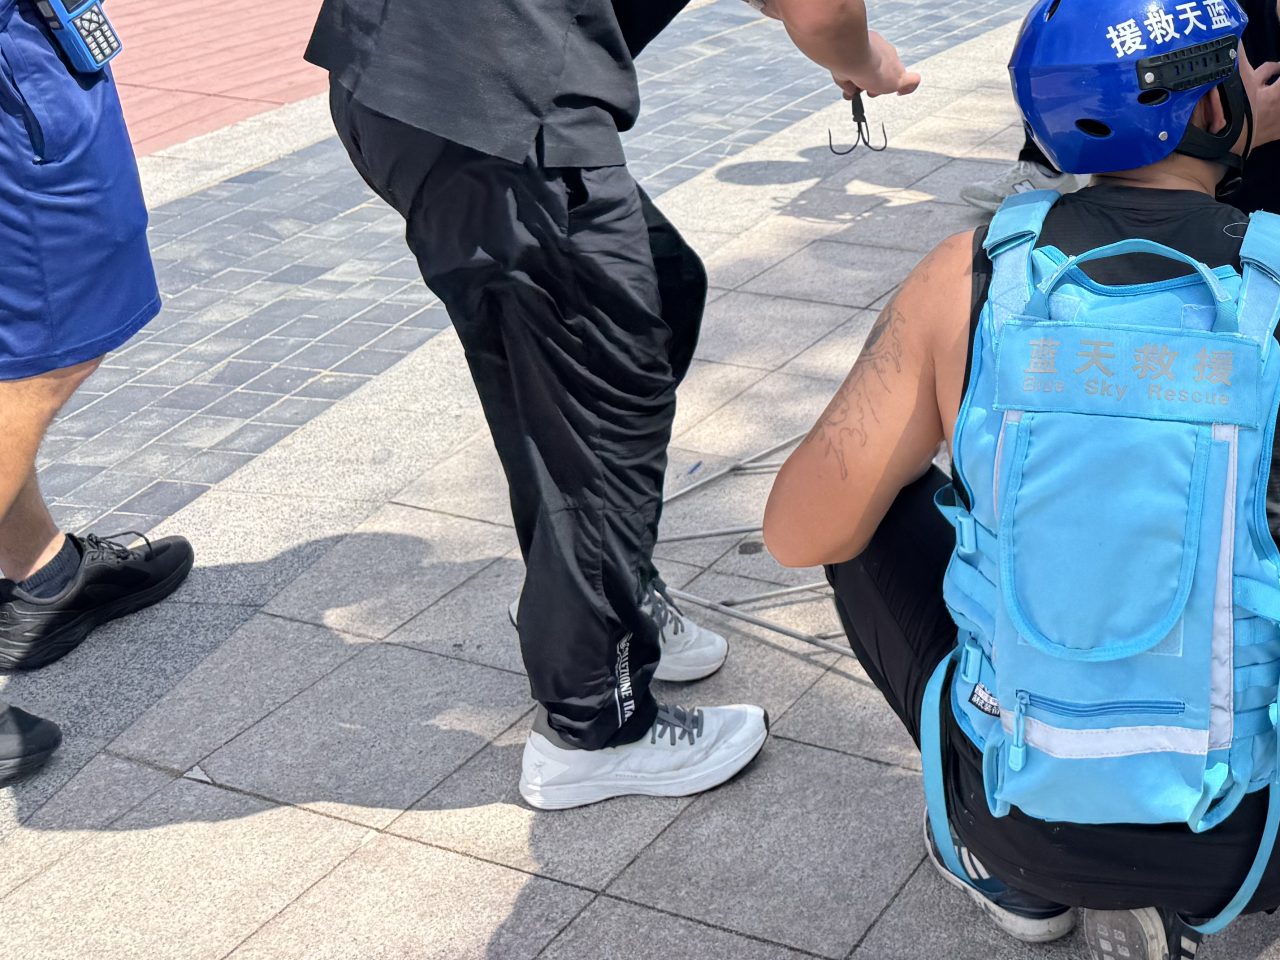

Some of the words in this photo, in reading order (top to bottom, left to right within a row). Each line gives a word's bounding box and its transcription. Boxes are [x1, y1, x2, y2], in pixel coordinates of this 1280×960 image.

[1024, 338, 1235, 387] 蓝天救援
[1084, 377, 1129, 402] Sky
[1148, 383, 1231, 406] Rescue
